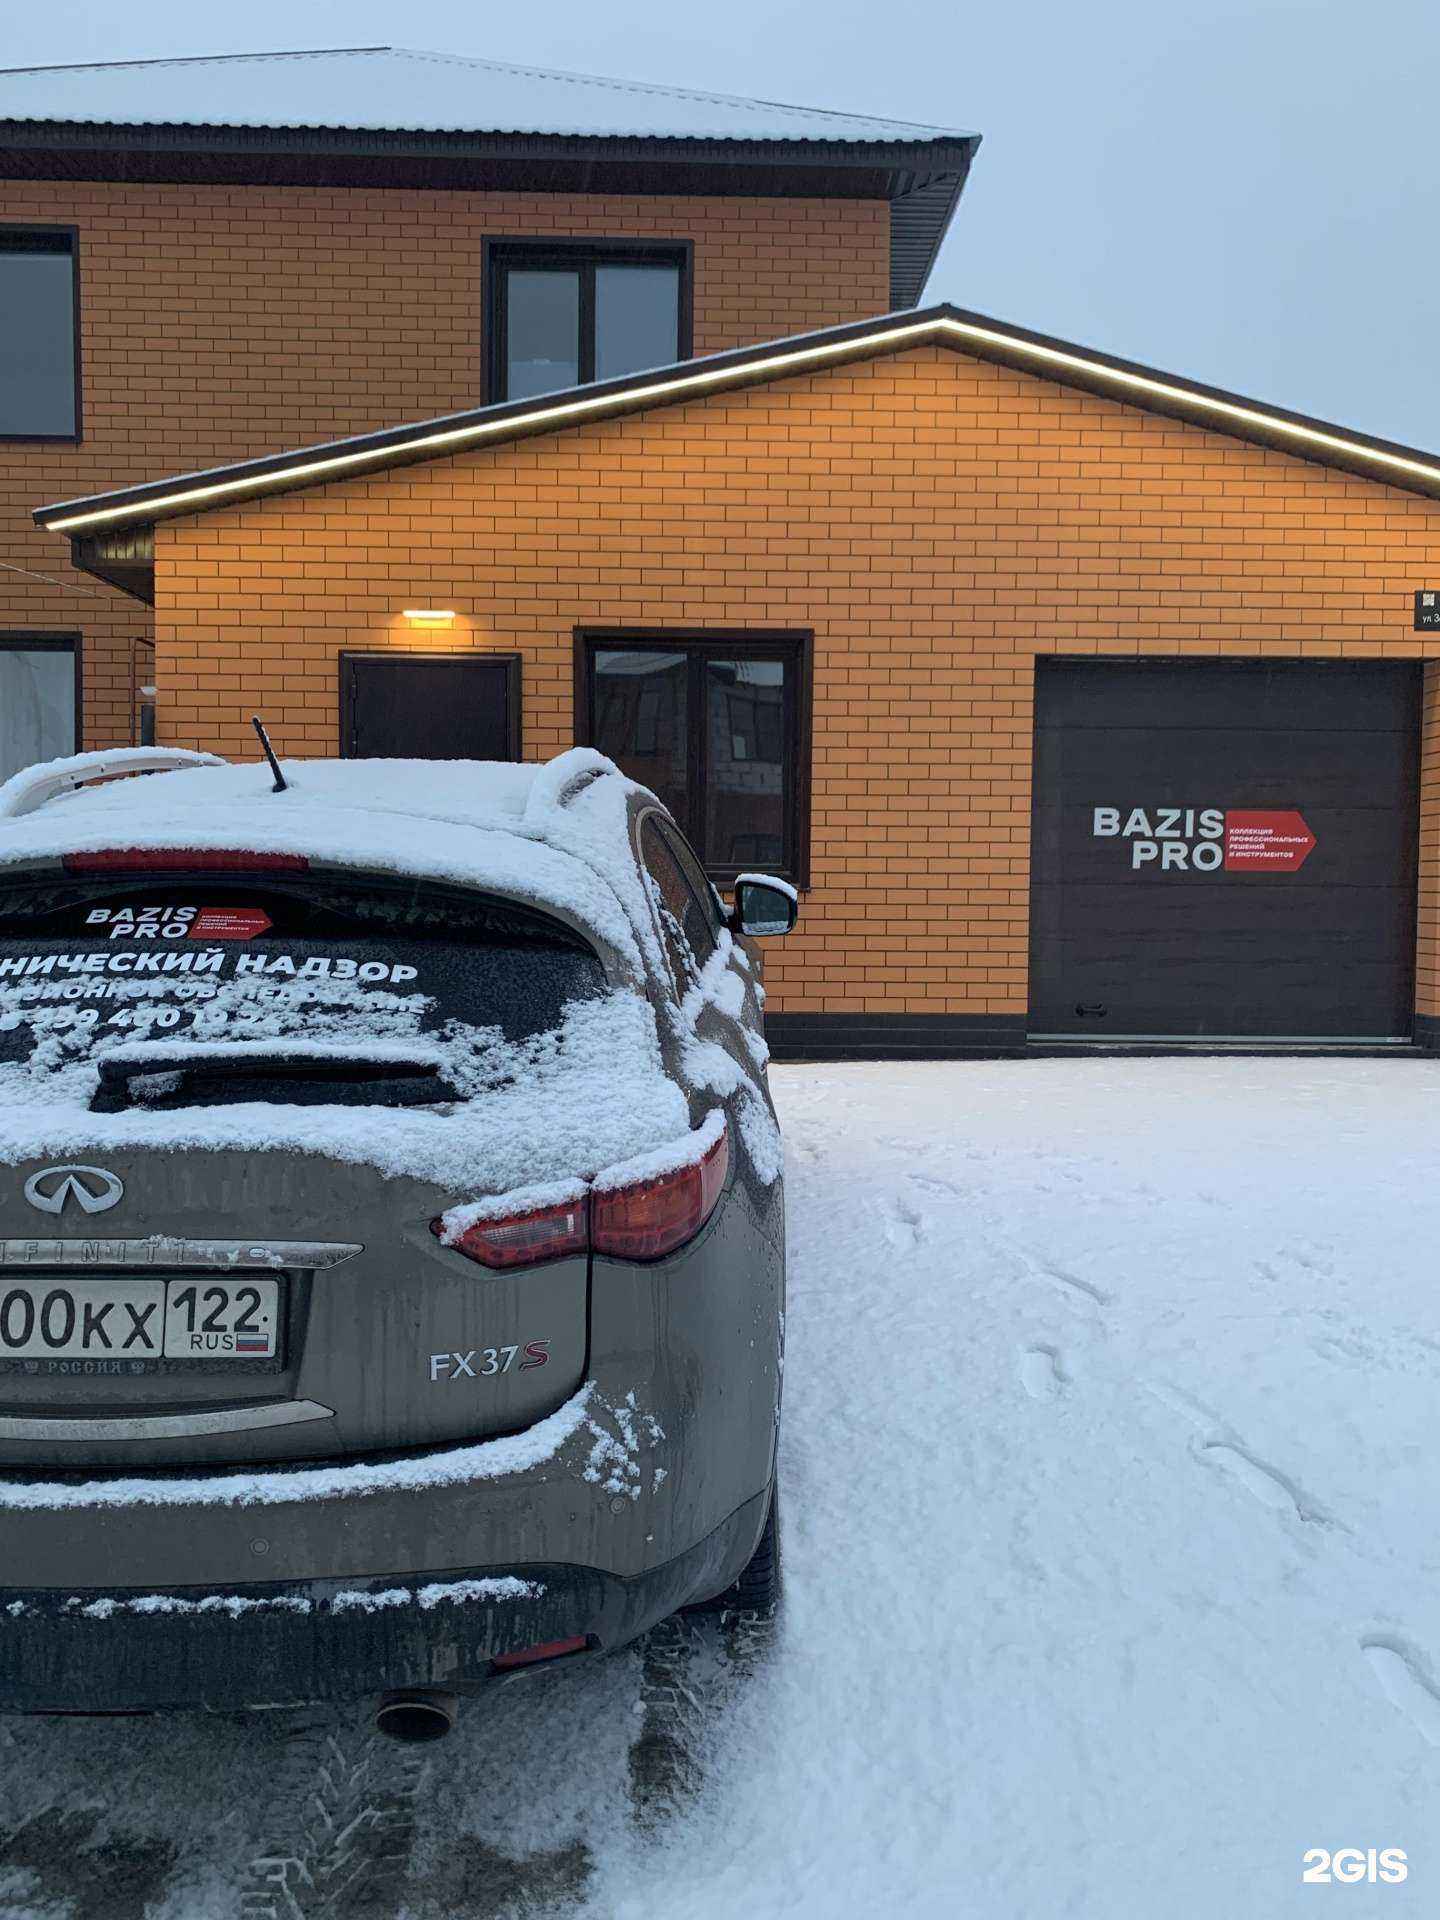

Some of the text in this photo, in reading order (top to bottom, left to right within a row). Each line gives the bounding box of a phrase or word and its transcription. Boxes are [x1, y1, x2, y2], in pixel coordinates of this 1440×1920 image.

[1093, 807, 1224, 838] BAZIS
[1132, 840, 1223, 871] PRO
[85, 906, 198, 924] BAZIS
[109, 922, 188, 939] PRO
[0, 948, 418, 983] НИЧЕСКИЙ НАДЗОР
[172, 1287, 261, 1333] 122
[190, 1334, 233, 1350] RUS
[48, 1361, 120, 1374] РОССИЯ
